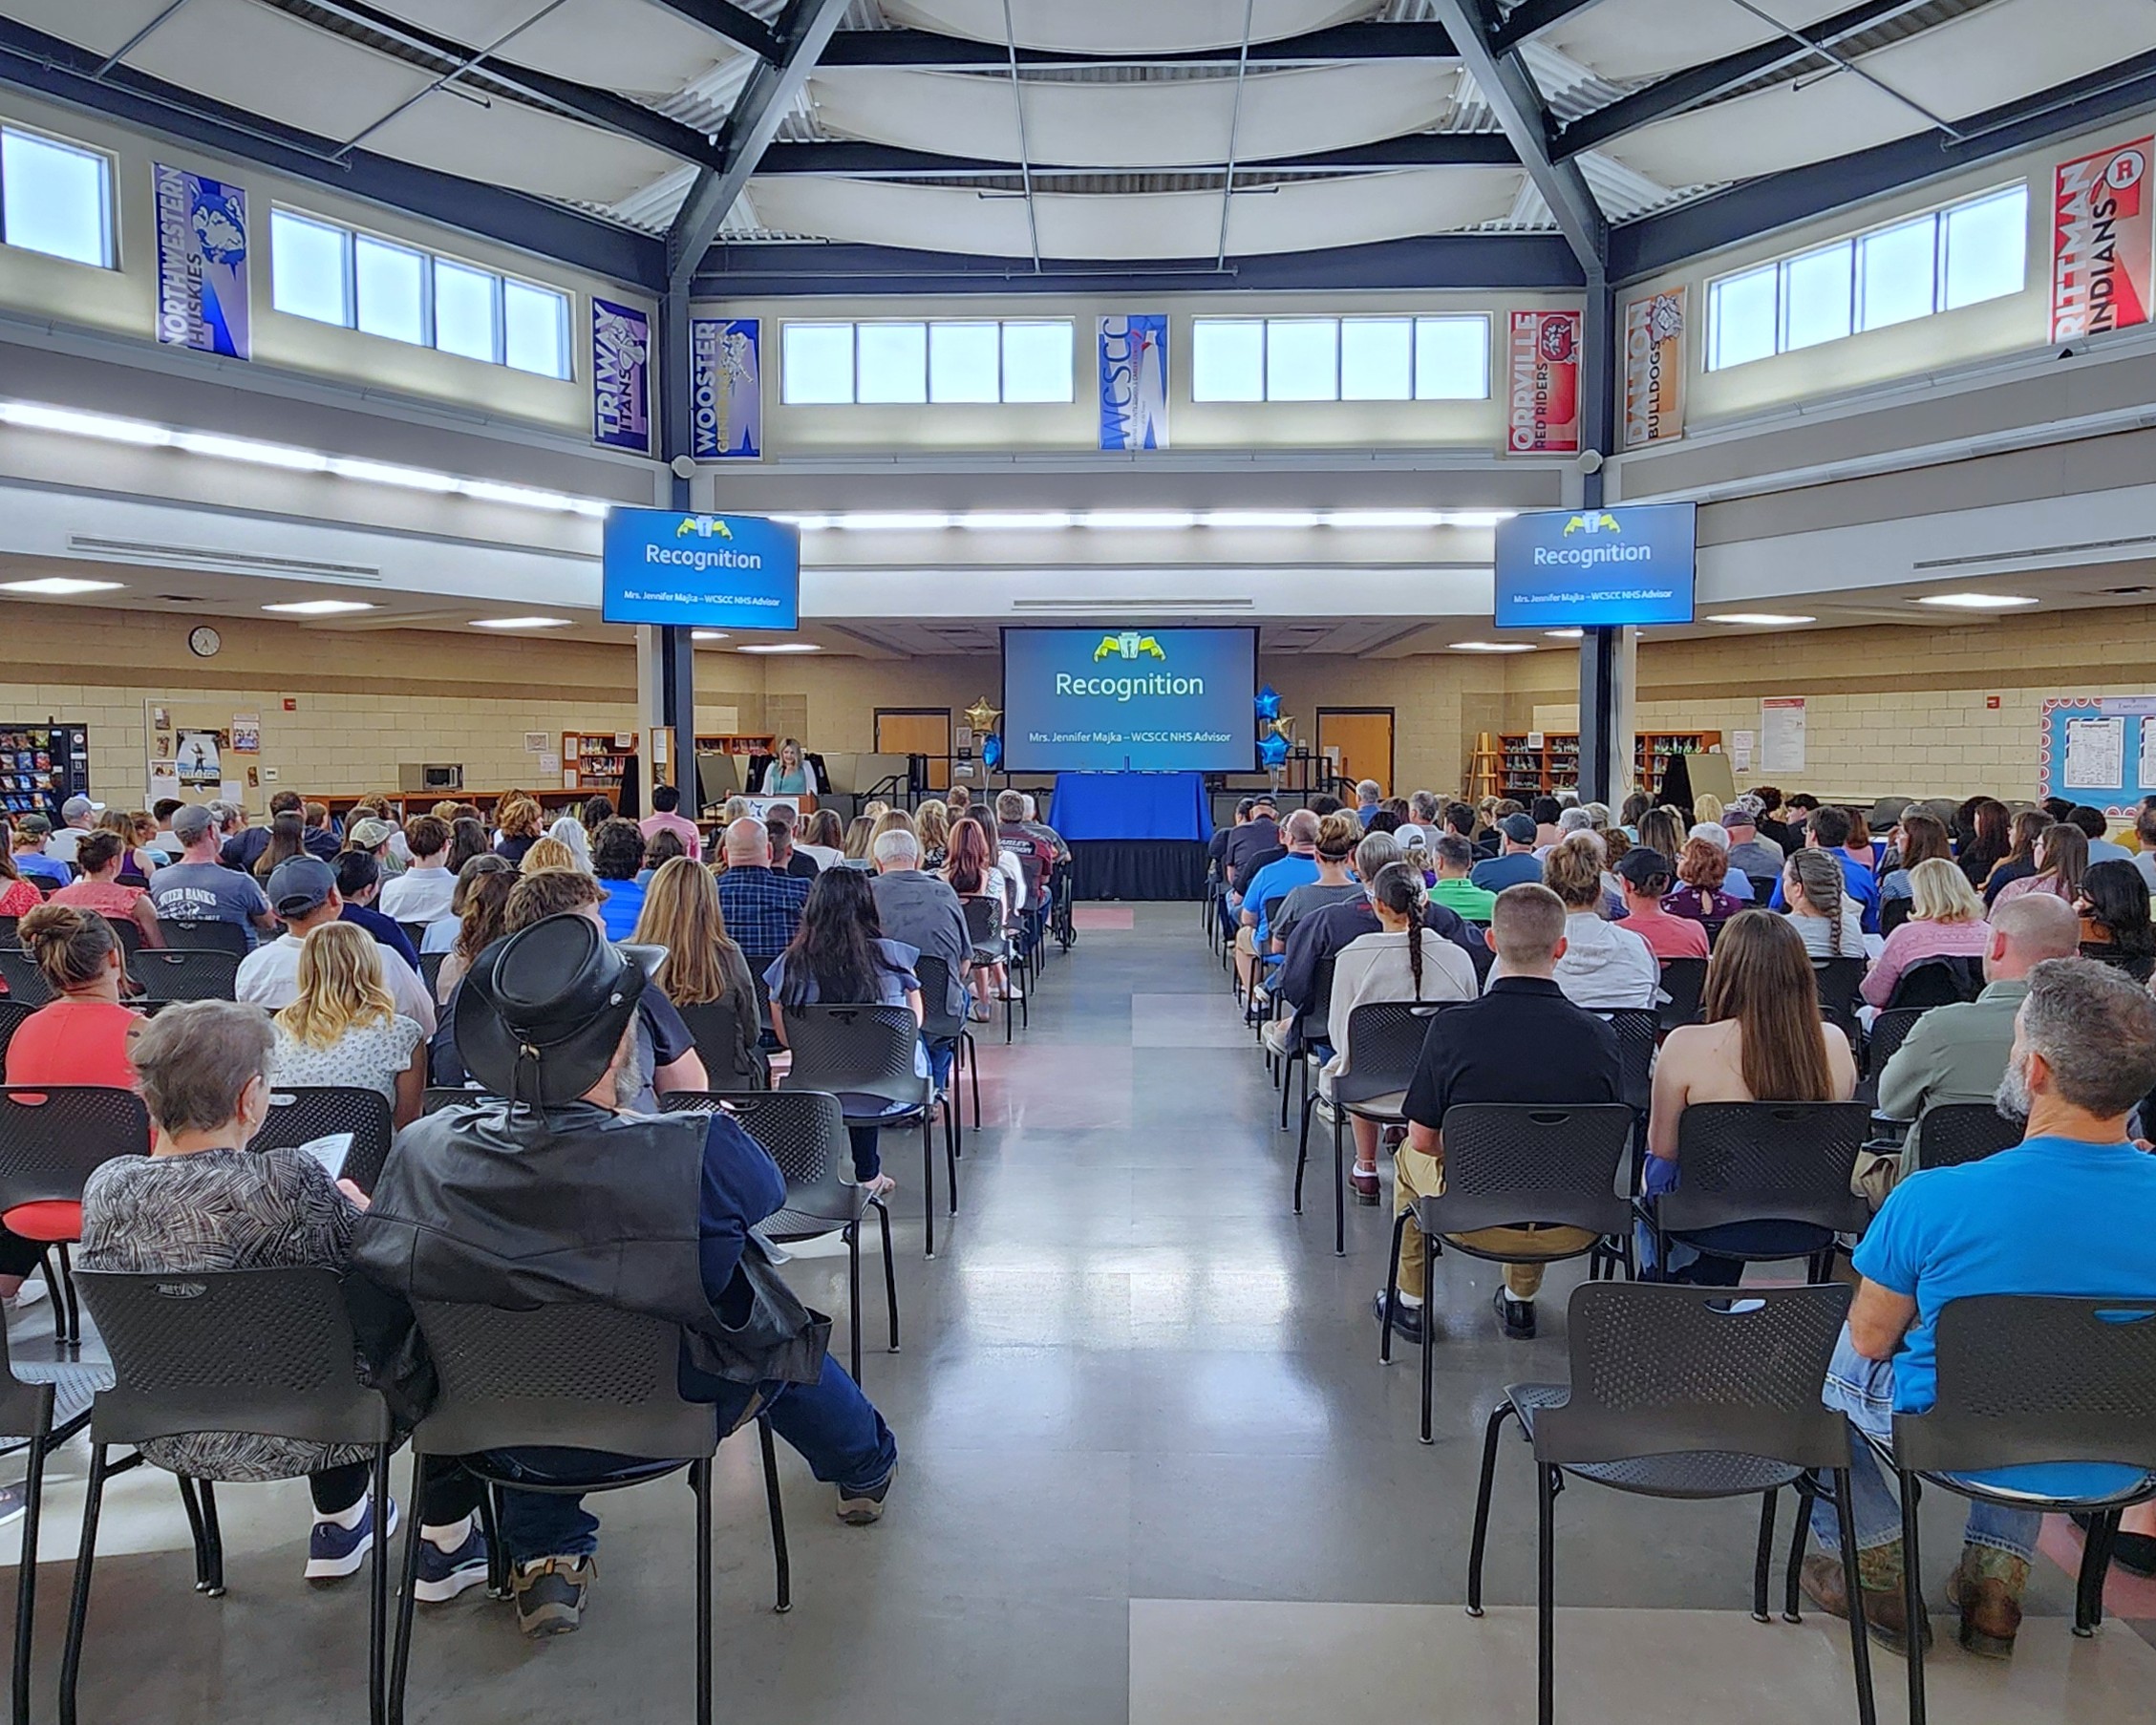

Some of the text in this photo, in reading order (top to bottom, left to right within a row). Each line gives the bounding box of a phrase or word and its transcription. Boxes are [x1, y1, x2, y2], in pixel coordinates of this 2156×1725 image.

[2116, 159, 2134, 182] R
[159, 164, 188, 349] NORTHWESTERN
[2056, 160, 2092, 343] RITTMAN
[2088, 197, 2118, 336] INDIANS
[186, 252, 204, 345] HUSKIES
[594, 302, 620, 437] TRIWAY
[694, 323, 716, 454] WOOSTER
[1102, 318, 1132, 444] WCSCC
[1512, 313, 1537, 450] ORRVILLE
[1535, 363, 1548, 448] RED RIDERS
[1628, 300, 1652, 445] DALTON
[1648, 341, 1661, 439] BULLDOGS
[624, 590, 642, 600] Mrs.
[643, 591, 673, 602] Jennifer
[704, 595, 734, 604] WCSCC
[735, 596, 752, 605] NHS
[752, 597, 780, 607] Advisor
[646, 543, 762, 571] Recognition
[1513, 594, 1530, 603] Mrs.
[1530, 593, 1561, 603] Jennifer
[1591, 591, 1622, 601] WCSCC
[1623, 590, 1641, 599] NHS
[1641, 589, 1673, 599] Advisor
[1534, 543, 1652, 569] Recognition
[1056, 672, 1205, 701] Recognition
[1029, 733, 1051, 742] Mrs.
[1052, 732, 1090, 742] Jennifer
[1092, 732, 1122, 744] Majka
[1131, 733, 1168, 742] WCSCC
[1170, 733, 1193, 742] NHS
[1193, 732, 1231, 742] Advisor
[184, 887, 217, 906] BANKS
